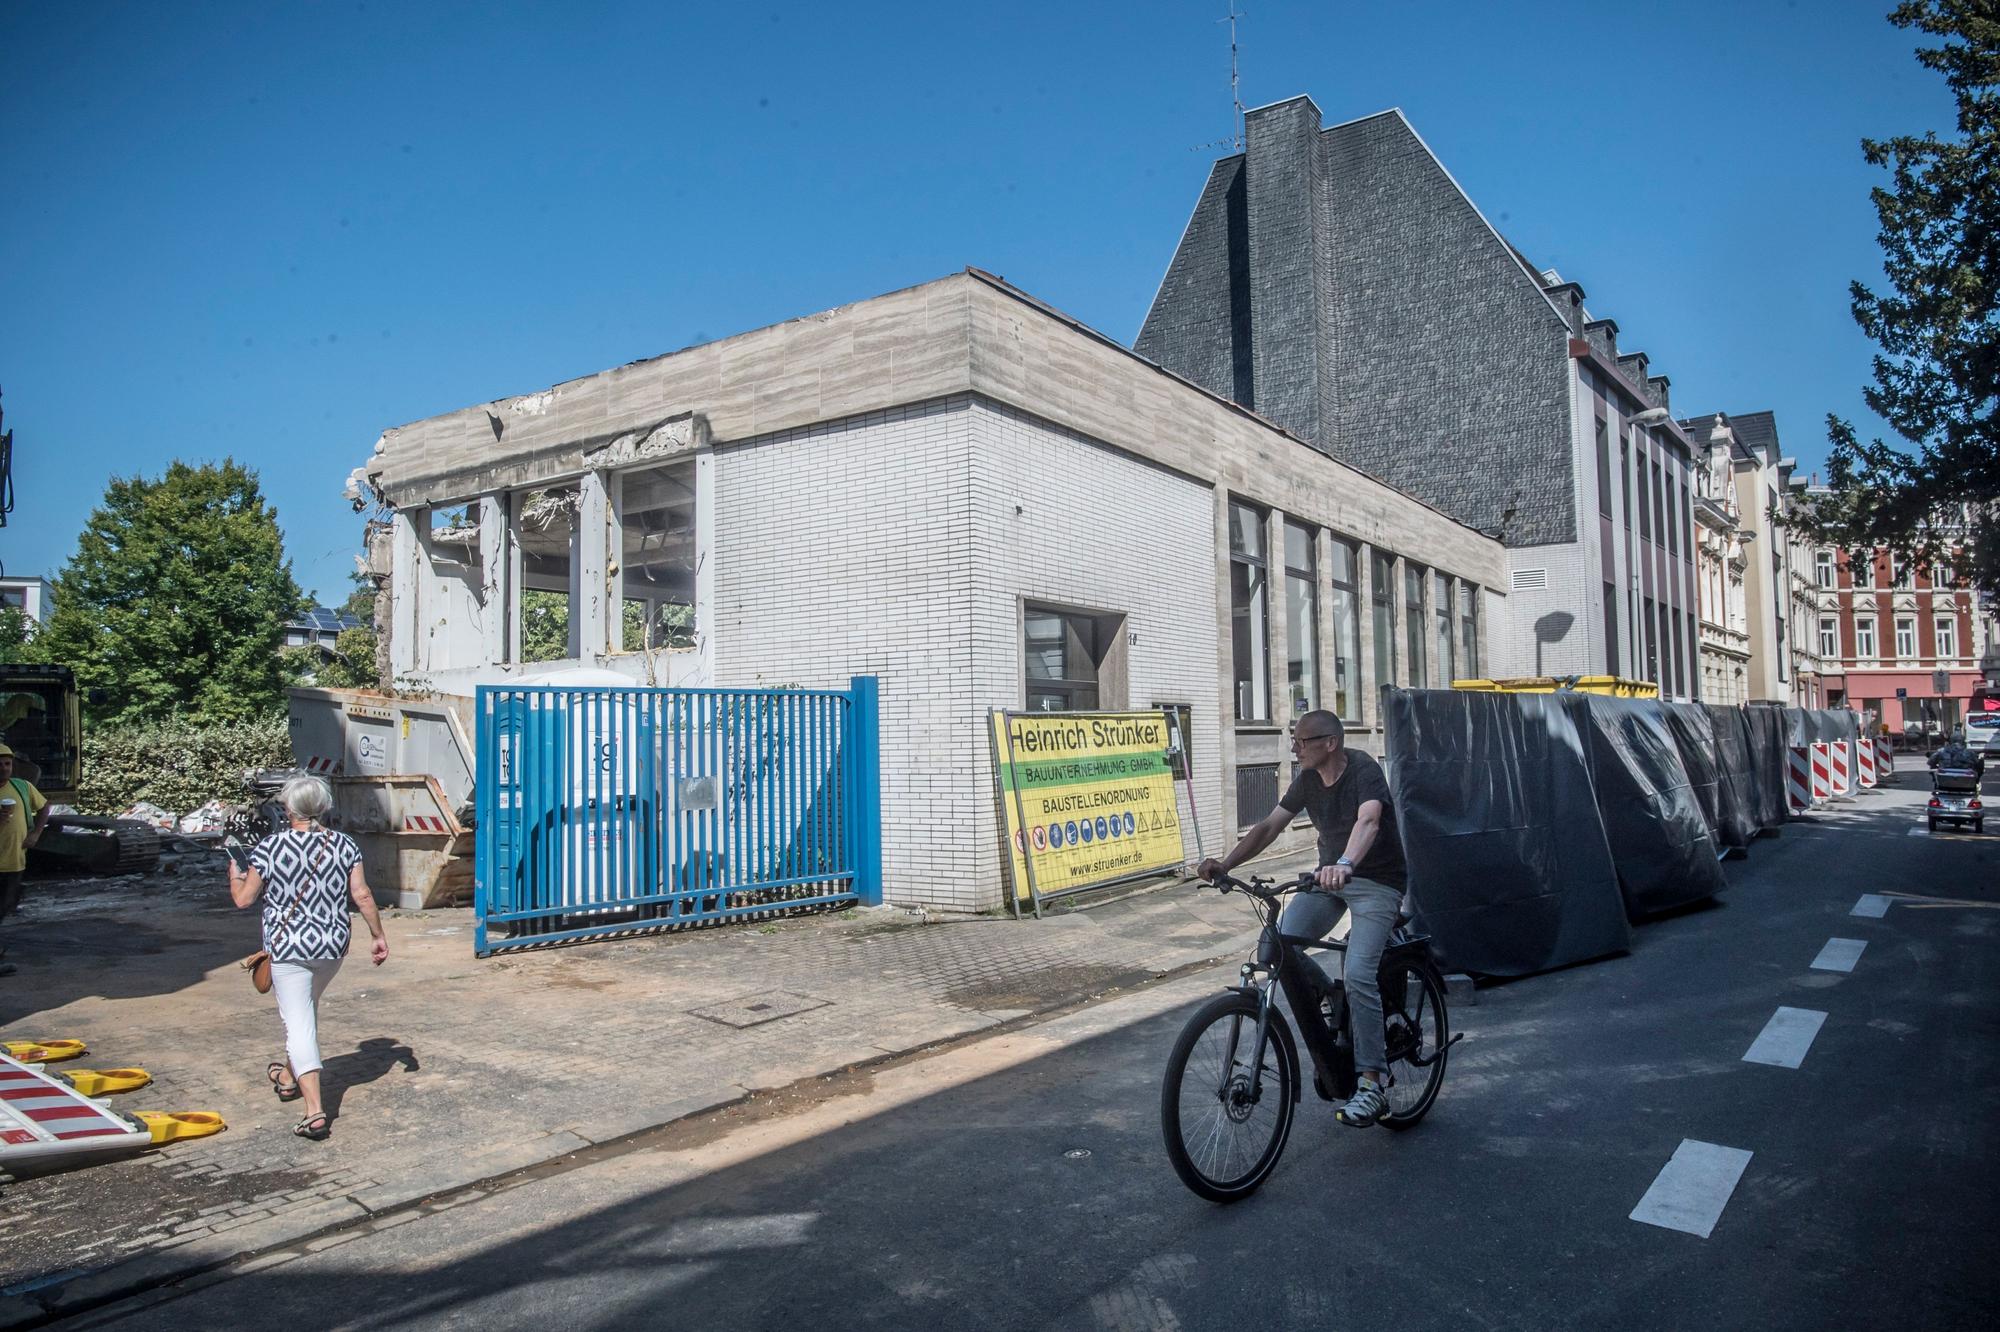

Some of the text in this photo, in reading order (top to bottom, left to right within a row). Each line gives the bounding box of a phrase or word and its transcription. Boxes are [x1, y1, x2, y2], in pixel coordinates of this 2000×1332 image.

[1011, 720, 1159, 752] Heinrich Strünker
[1026, 757, 1155, 783] BAUUNTERNEHMUNG GMBH
[1043, 786, 1150, 814] BAUSTELLENORDNUNG
[1070, 850, 1143, 877] www.struenker.de
